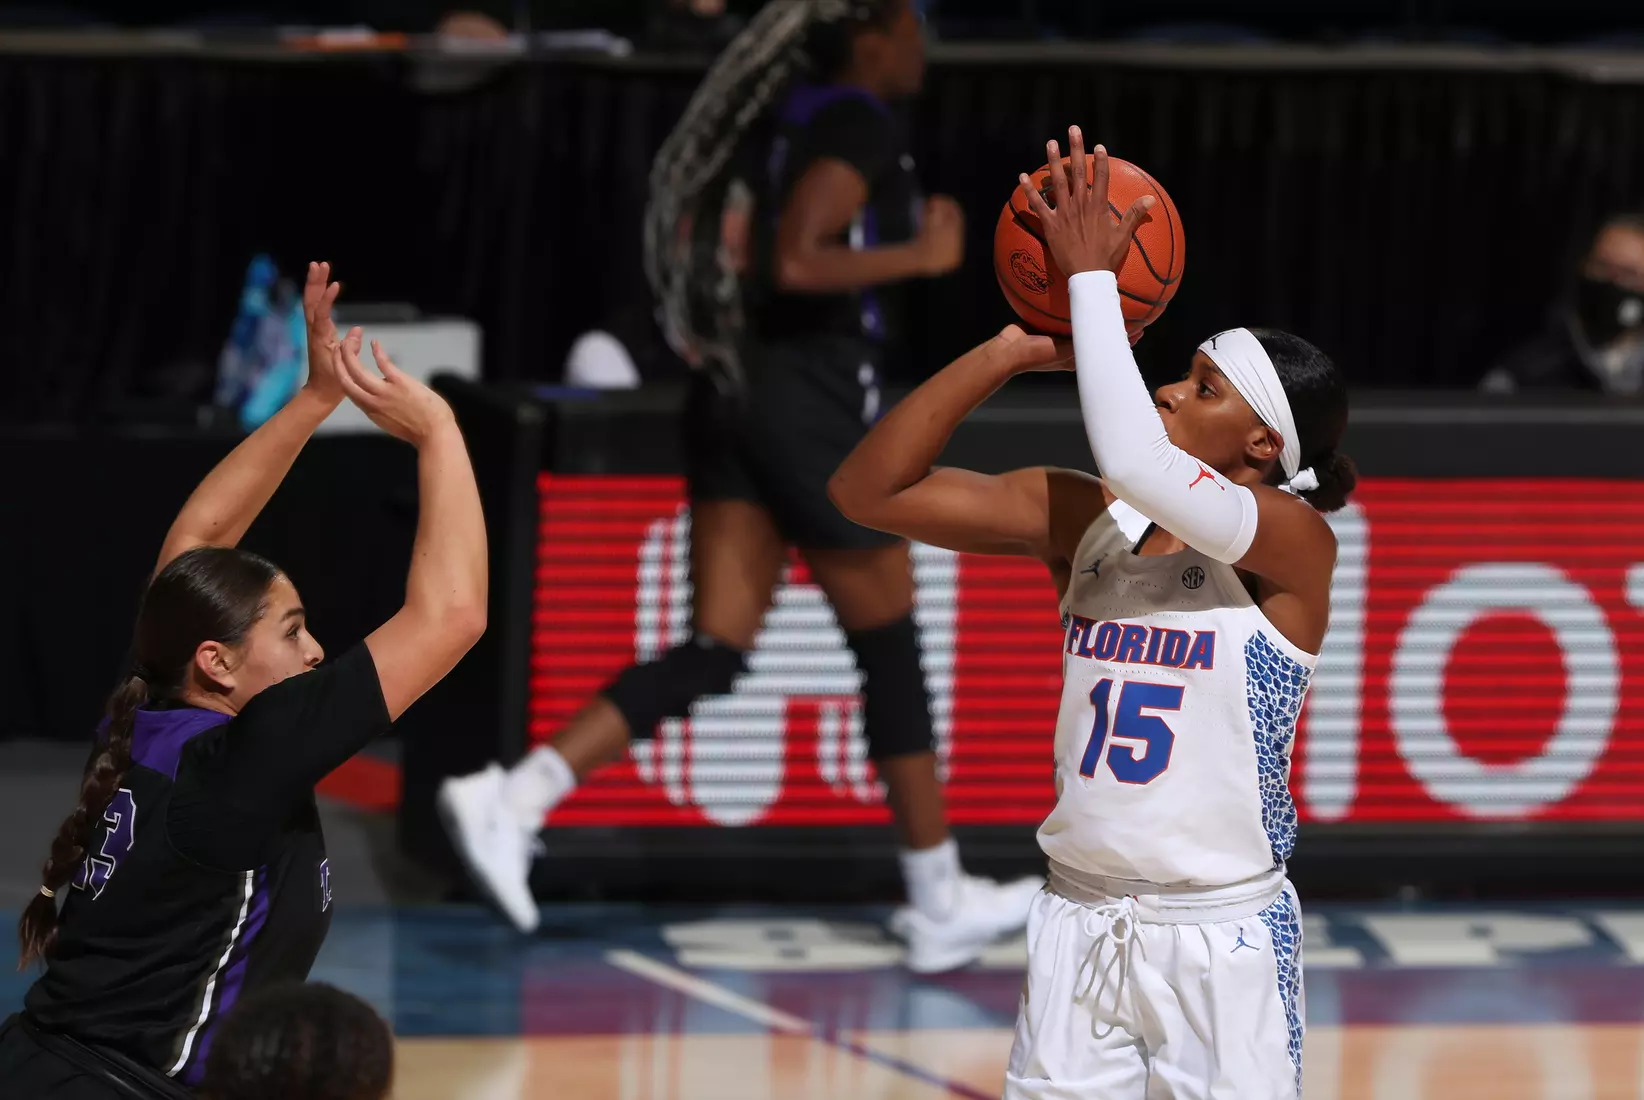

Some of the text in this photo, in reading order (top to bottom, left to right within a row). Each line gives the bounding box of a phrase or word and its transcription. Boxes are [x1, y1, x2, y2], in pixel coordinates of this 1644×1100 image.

[1182, 566, 1205, 589] SEC
[1066, 614, 1216, 671] FLORIDA
[1079, 677, 1186, 786] 15
